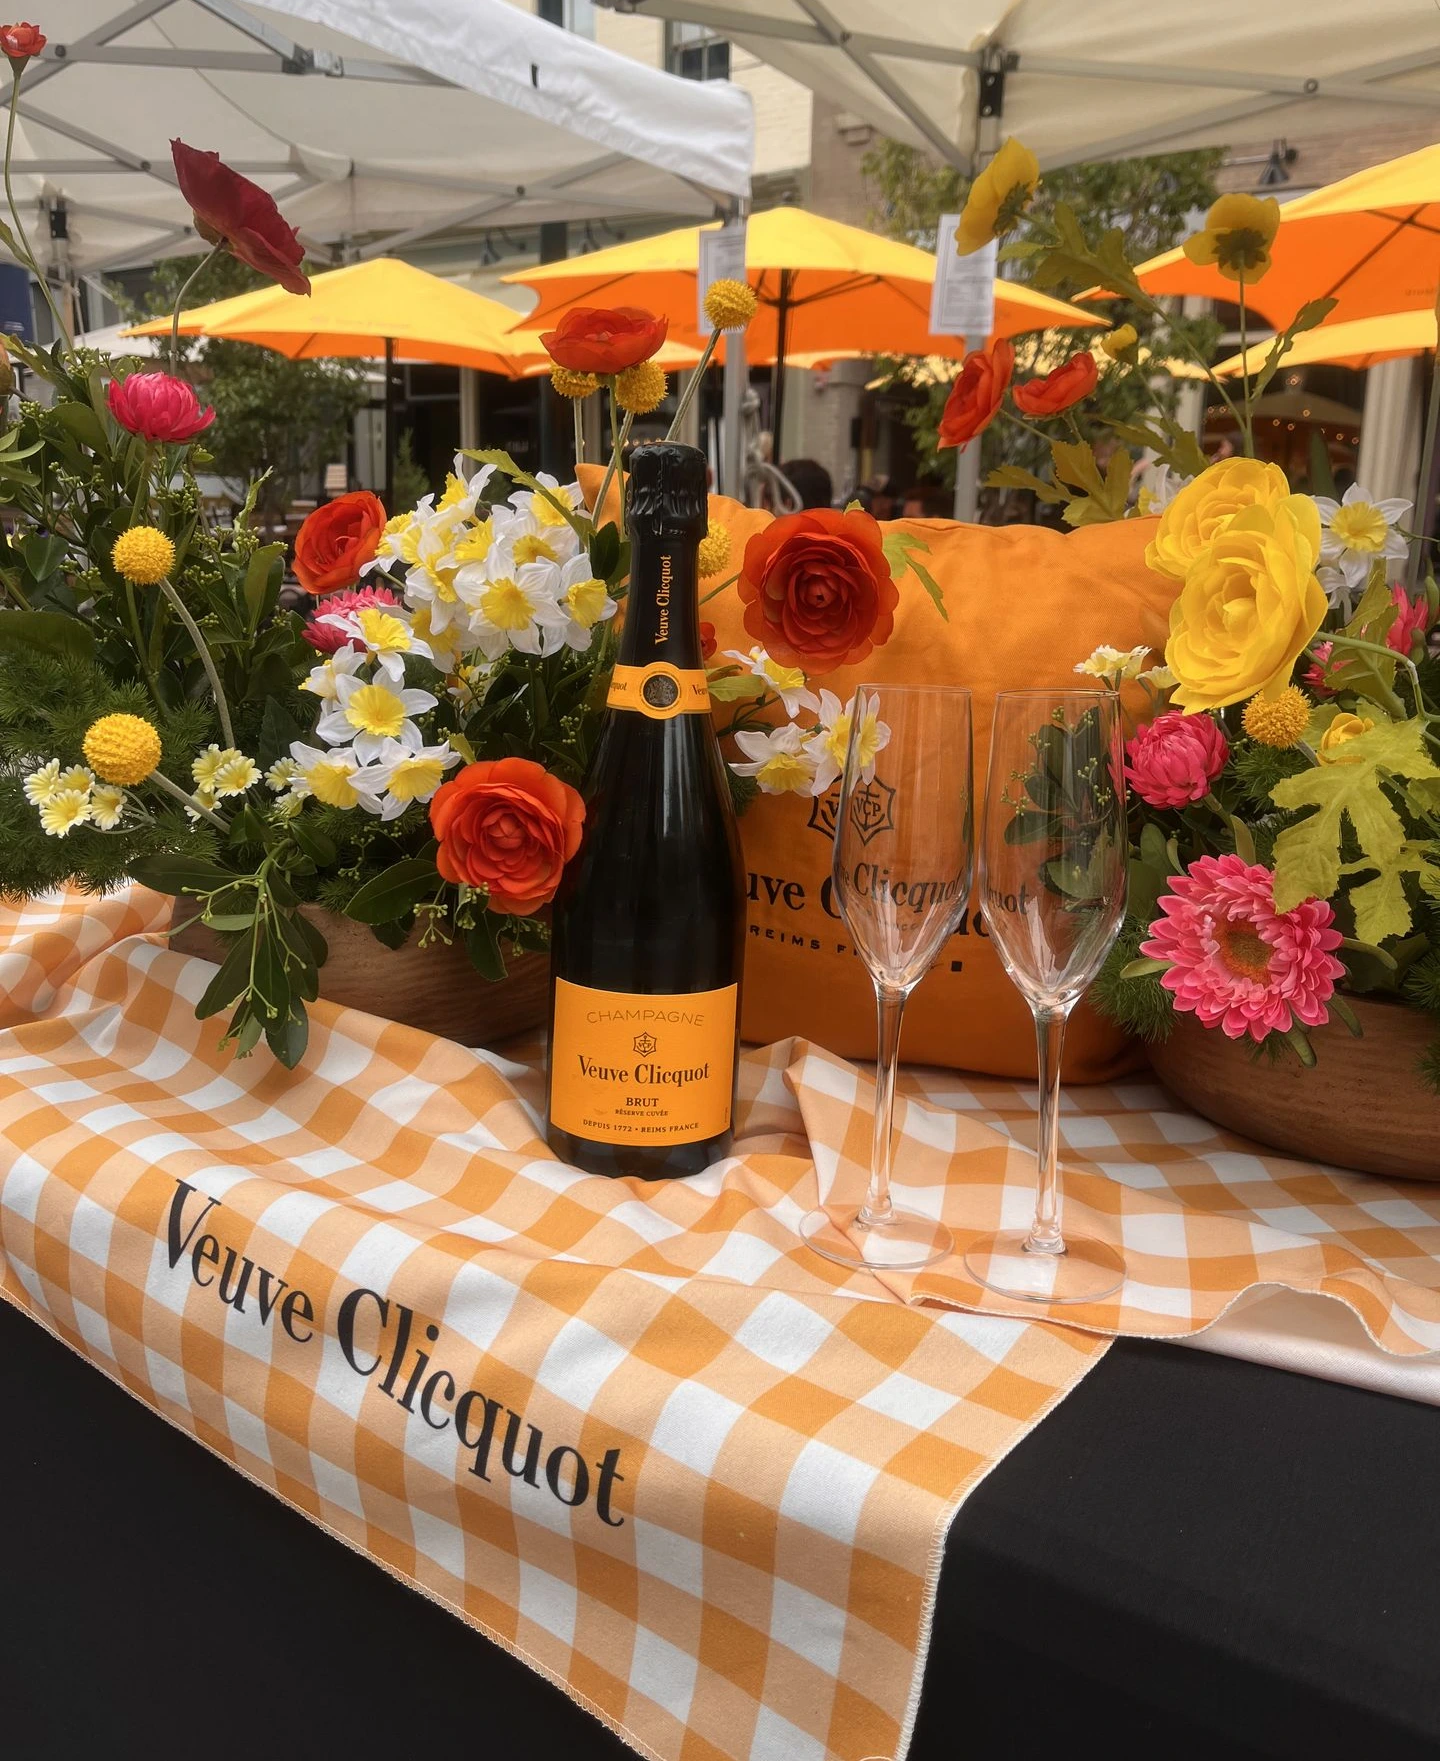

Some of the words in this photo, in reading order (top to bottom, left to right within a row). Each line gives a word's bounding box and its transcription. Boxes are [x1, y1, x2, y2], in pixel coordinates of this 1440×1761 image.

[656, 554, 674, 607] Clicquot
[655, 608, 669, 645] Veuve
[750, 924, 820, 950] REIMS
[586, 1009, 705, 1027] CHAMPAGNE
[577, 1054, 629, 1083] Veuve
[634, 1062, 710, 1088] Clicquot
[615, 1108, 645, 1117] RÉSERVE
[646, 1109, 669, 1117] CUVÉE
[626, 1097, 660, 1108] BRUT
[583, 1119, 611, 1130] DEPUIS
[613, 1124, 632, 1132] 1772
[669, 1122, 700, 1132] FRANCE
[167, 1178, 315, 1343] Veuve
[336, 1287, 626, 1528] Clicquot
